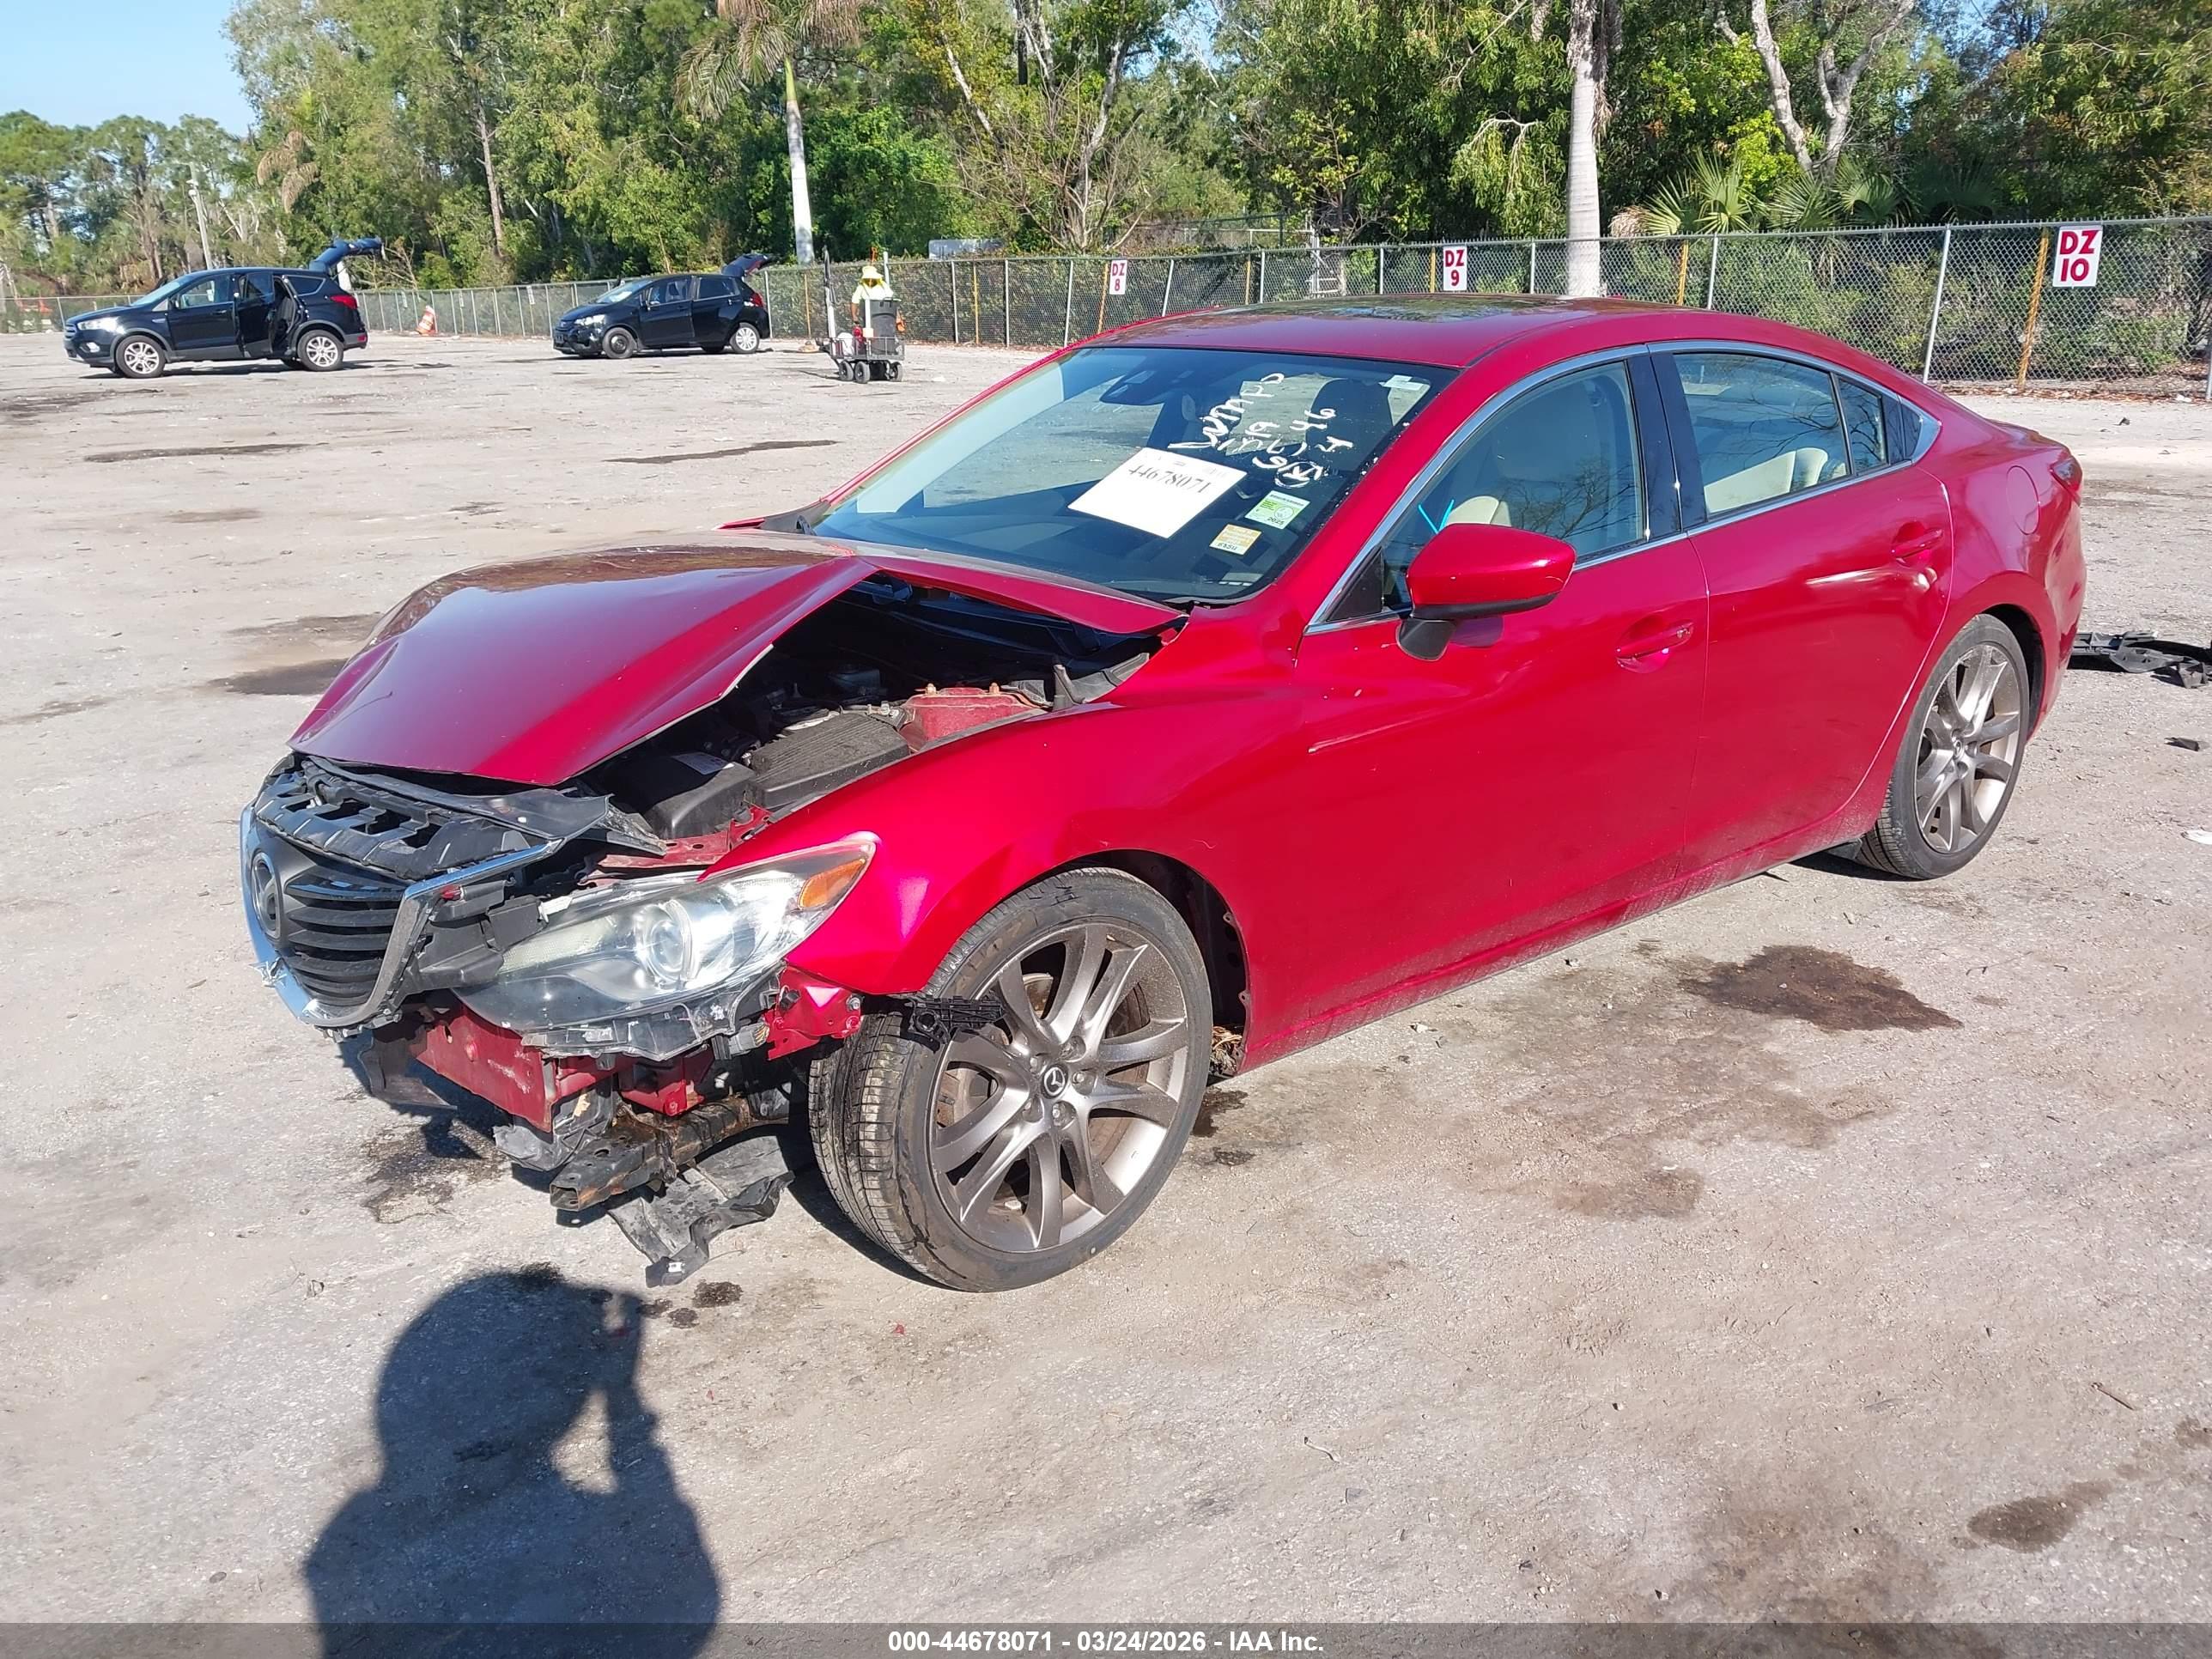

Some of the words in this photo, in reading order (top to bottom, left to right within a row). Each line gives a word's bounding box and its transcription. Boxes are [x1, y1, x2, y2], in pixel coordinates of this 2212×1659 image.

[2059, 229, 2100, 255] DZ
[1444, 249, 1465, 267] DZ
[1112, 263, 1126, 276] DZ
[1450, 269, 1460, 287] 9
[2060, 258, 2089, 282] 10
[1114, 278, 1121, 291] 8
[1128, 465, 1212, 493] 44678071
